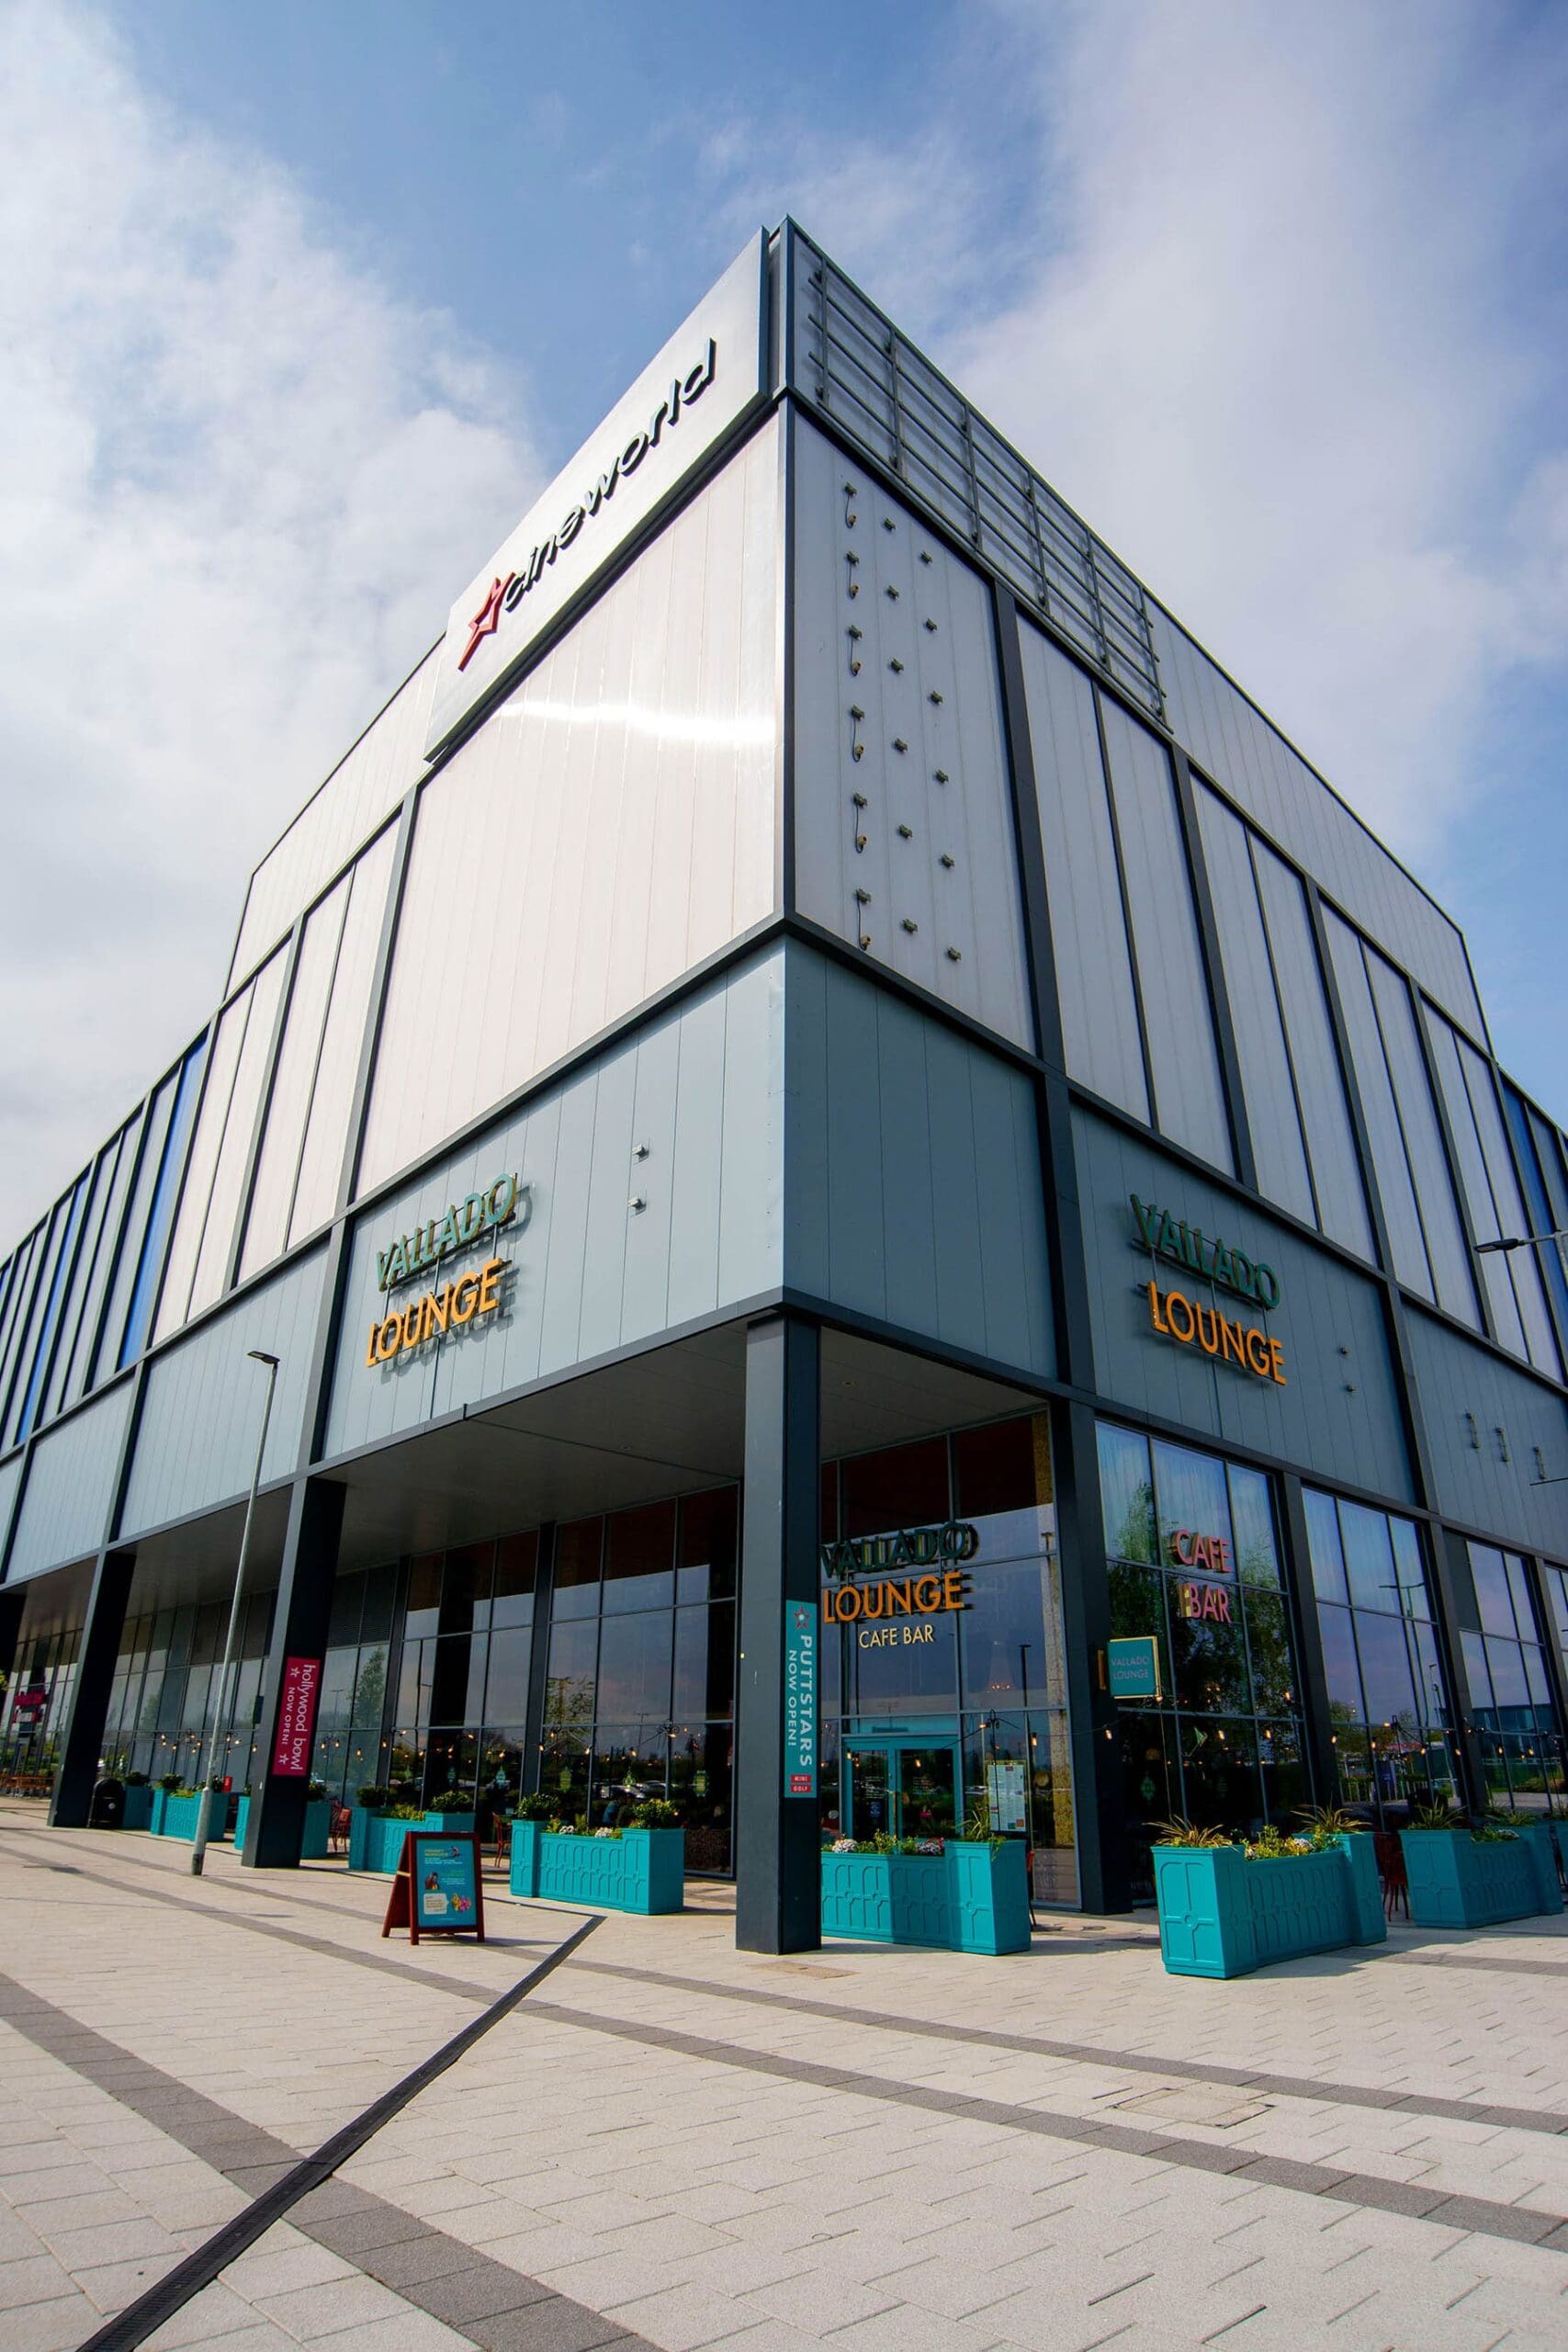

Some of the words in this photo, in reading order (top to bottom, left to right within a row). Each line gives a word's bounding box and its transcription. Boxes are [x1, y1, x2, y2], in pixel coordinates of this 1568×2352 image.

[504, 337, 716, 613] cineworld
[376, 1172, 517, 1292] VALLADO
[1130, 1193, 1280, 1309] VALLADO
[365, 1257, 503, 1367] LOUNGE
[1147, 1279, 1287, 1386] LOUNGE
[820, 1521, 974, 1578] VALLADO
[1171, 1528, 1234, 1574] CAFE
[823, 1572, 967, 1623] LOUNGE
[1183, 1582, 1232, 1625] BAR
[858, 1627, 898, 1648] CAFE
[903, 1623, 934, 1645] BAR
[1111, 1655, 1150, 1667] VALLADO
[788, 1649, 797, 1691] NOW
[1112, 1668, 1149, 1680] LOUNGE
[286, 1687, 296, 1712] NOW
[296, 1664, 316, 1732] hollywood
[787, 1696, 797, 1747] OPEN!
[799, 1634, 813, 1767] PUTTSTARS
[281, 1714, 291, 1745] OPEN!
[290, 1737, 307, 1770] bowl
